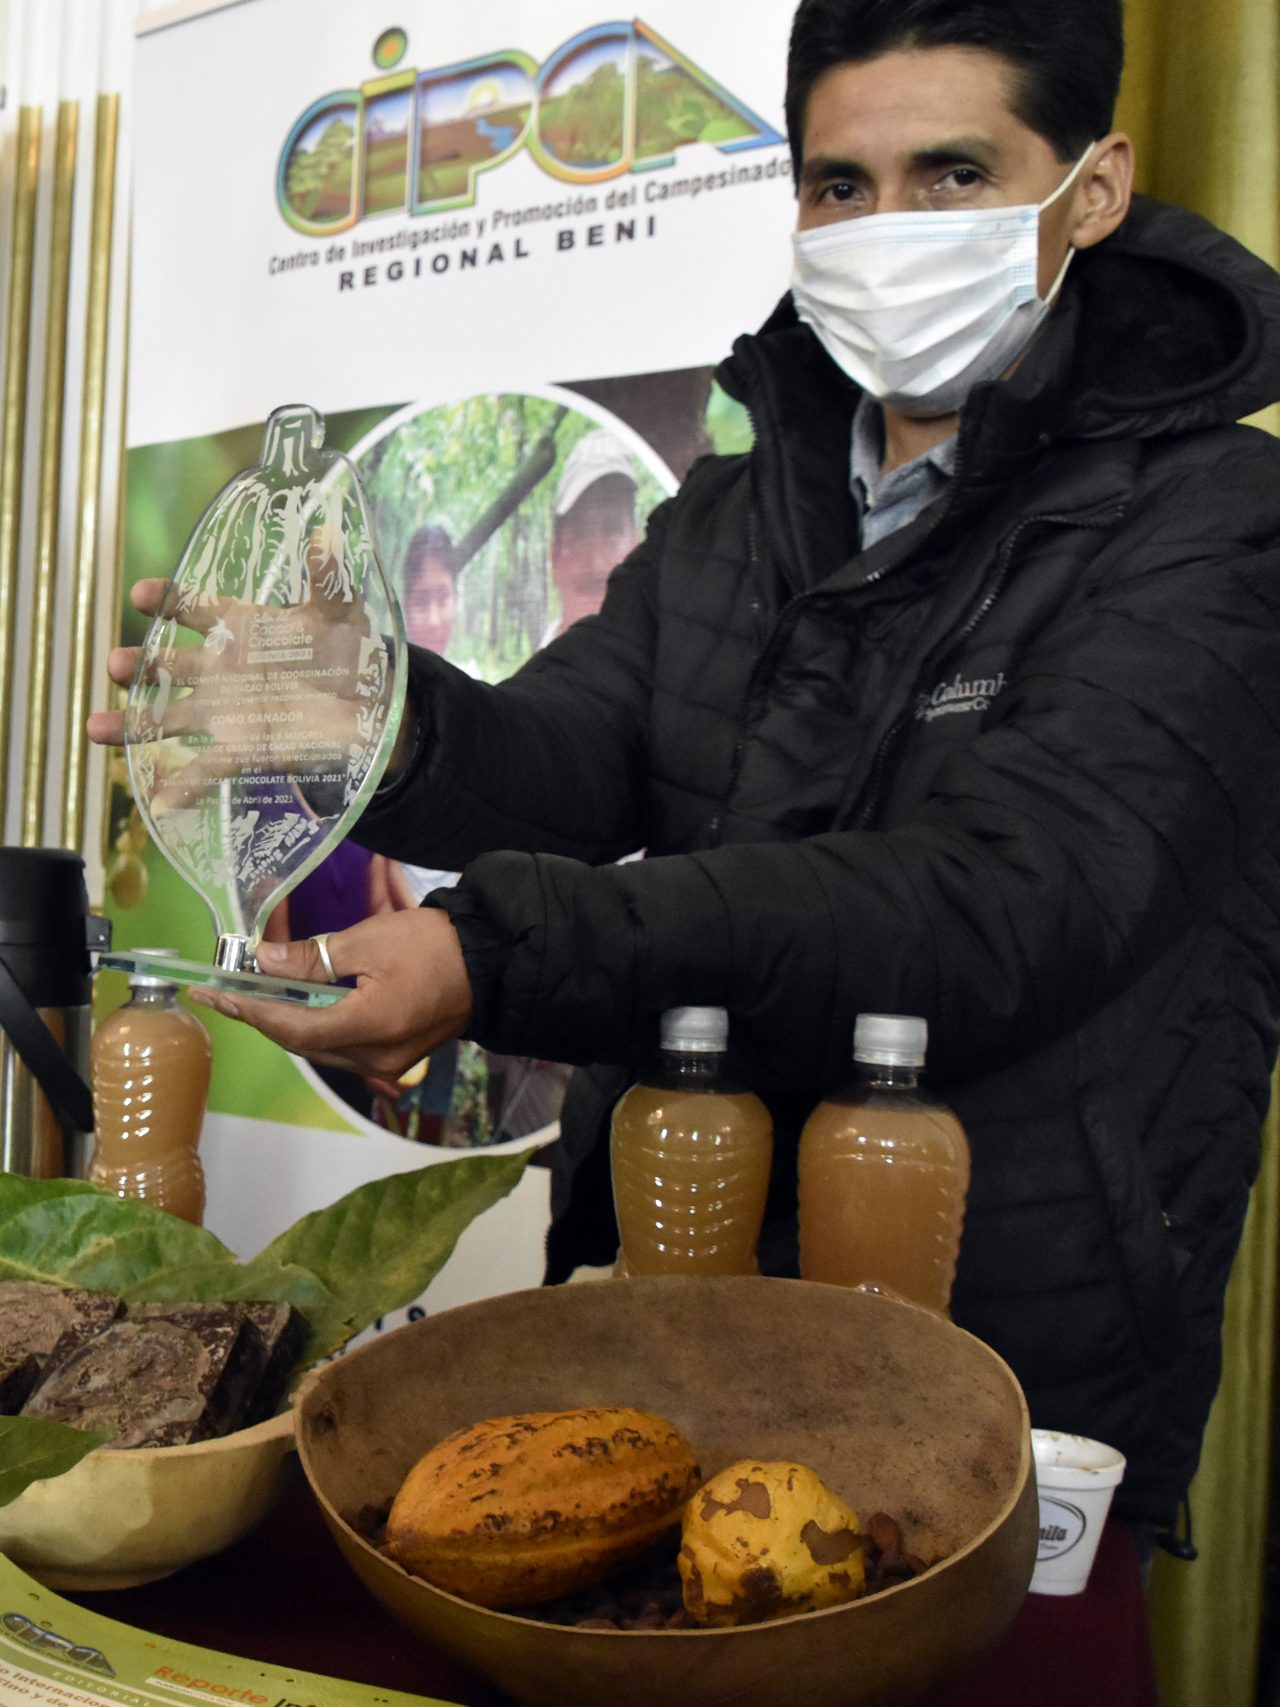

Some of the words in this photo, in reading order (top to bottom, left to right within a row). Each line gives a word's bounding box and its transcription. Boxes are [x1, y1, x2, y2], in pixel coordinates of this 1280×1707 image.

[269, 252, 320, 276] Centro
[325, 243, 347, 261] de
[352, 218, 470, 258] Investigación
[476, 219, 486, 237] y
[492, 192, 598, 229] Promoción
[604, 186, 637, 210] del
[644, 156, 792, 203] Campesinado
[339, 239, 530, 292] REGIONAL
[557, 215, 656, 251] BENI
[248, 633, 313, 648] Chocolate
[211, 714, 244, 726] COMO
[247, 711, 304, 724] GANADOR
[238, 775, 285, 785] CHOCOLATE
[287, 774, 320, 783] BOLIVIA
[243, 795, 261, 804] Abril
[263, 795, 272, 804] de
[274, 794, 294, 804] 2021
[52, 1671, 150, 1707] EDITORIAL
[153, 1665, 269, 1704] Reporte
